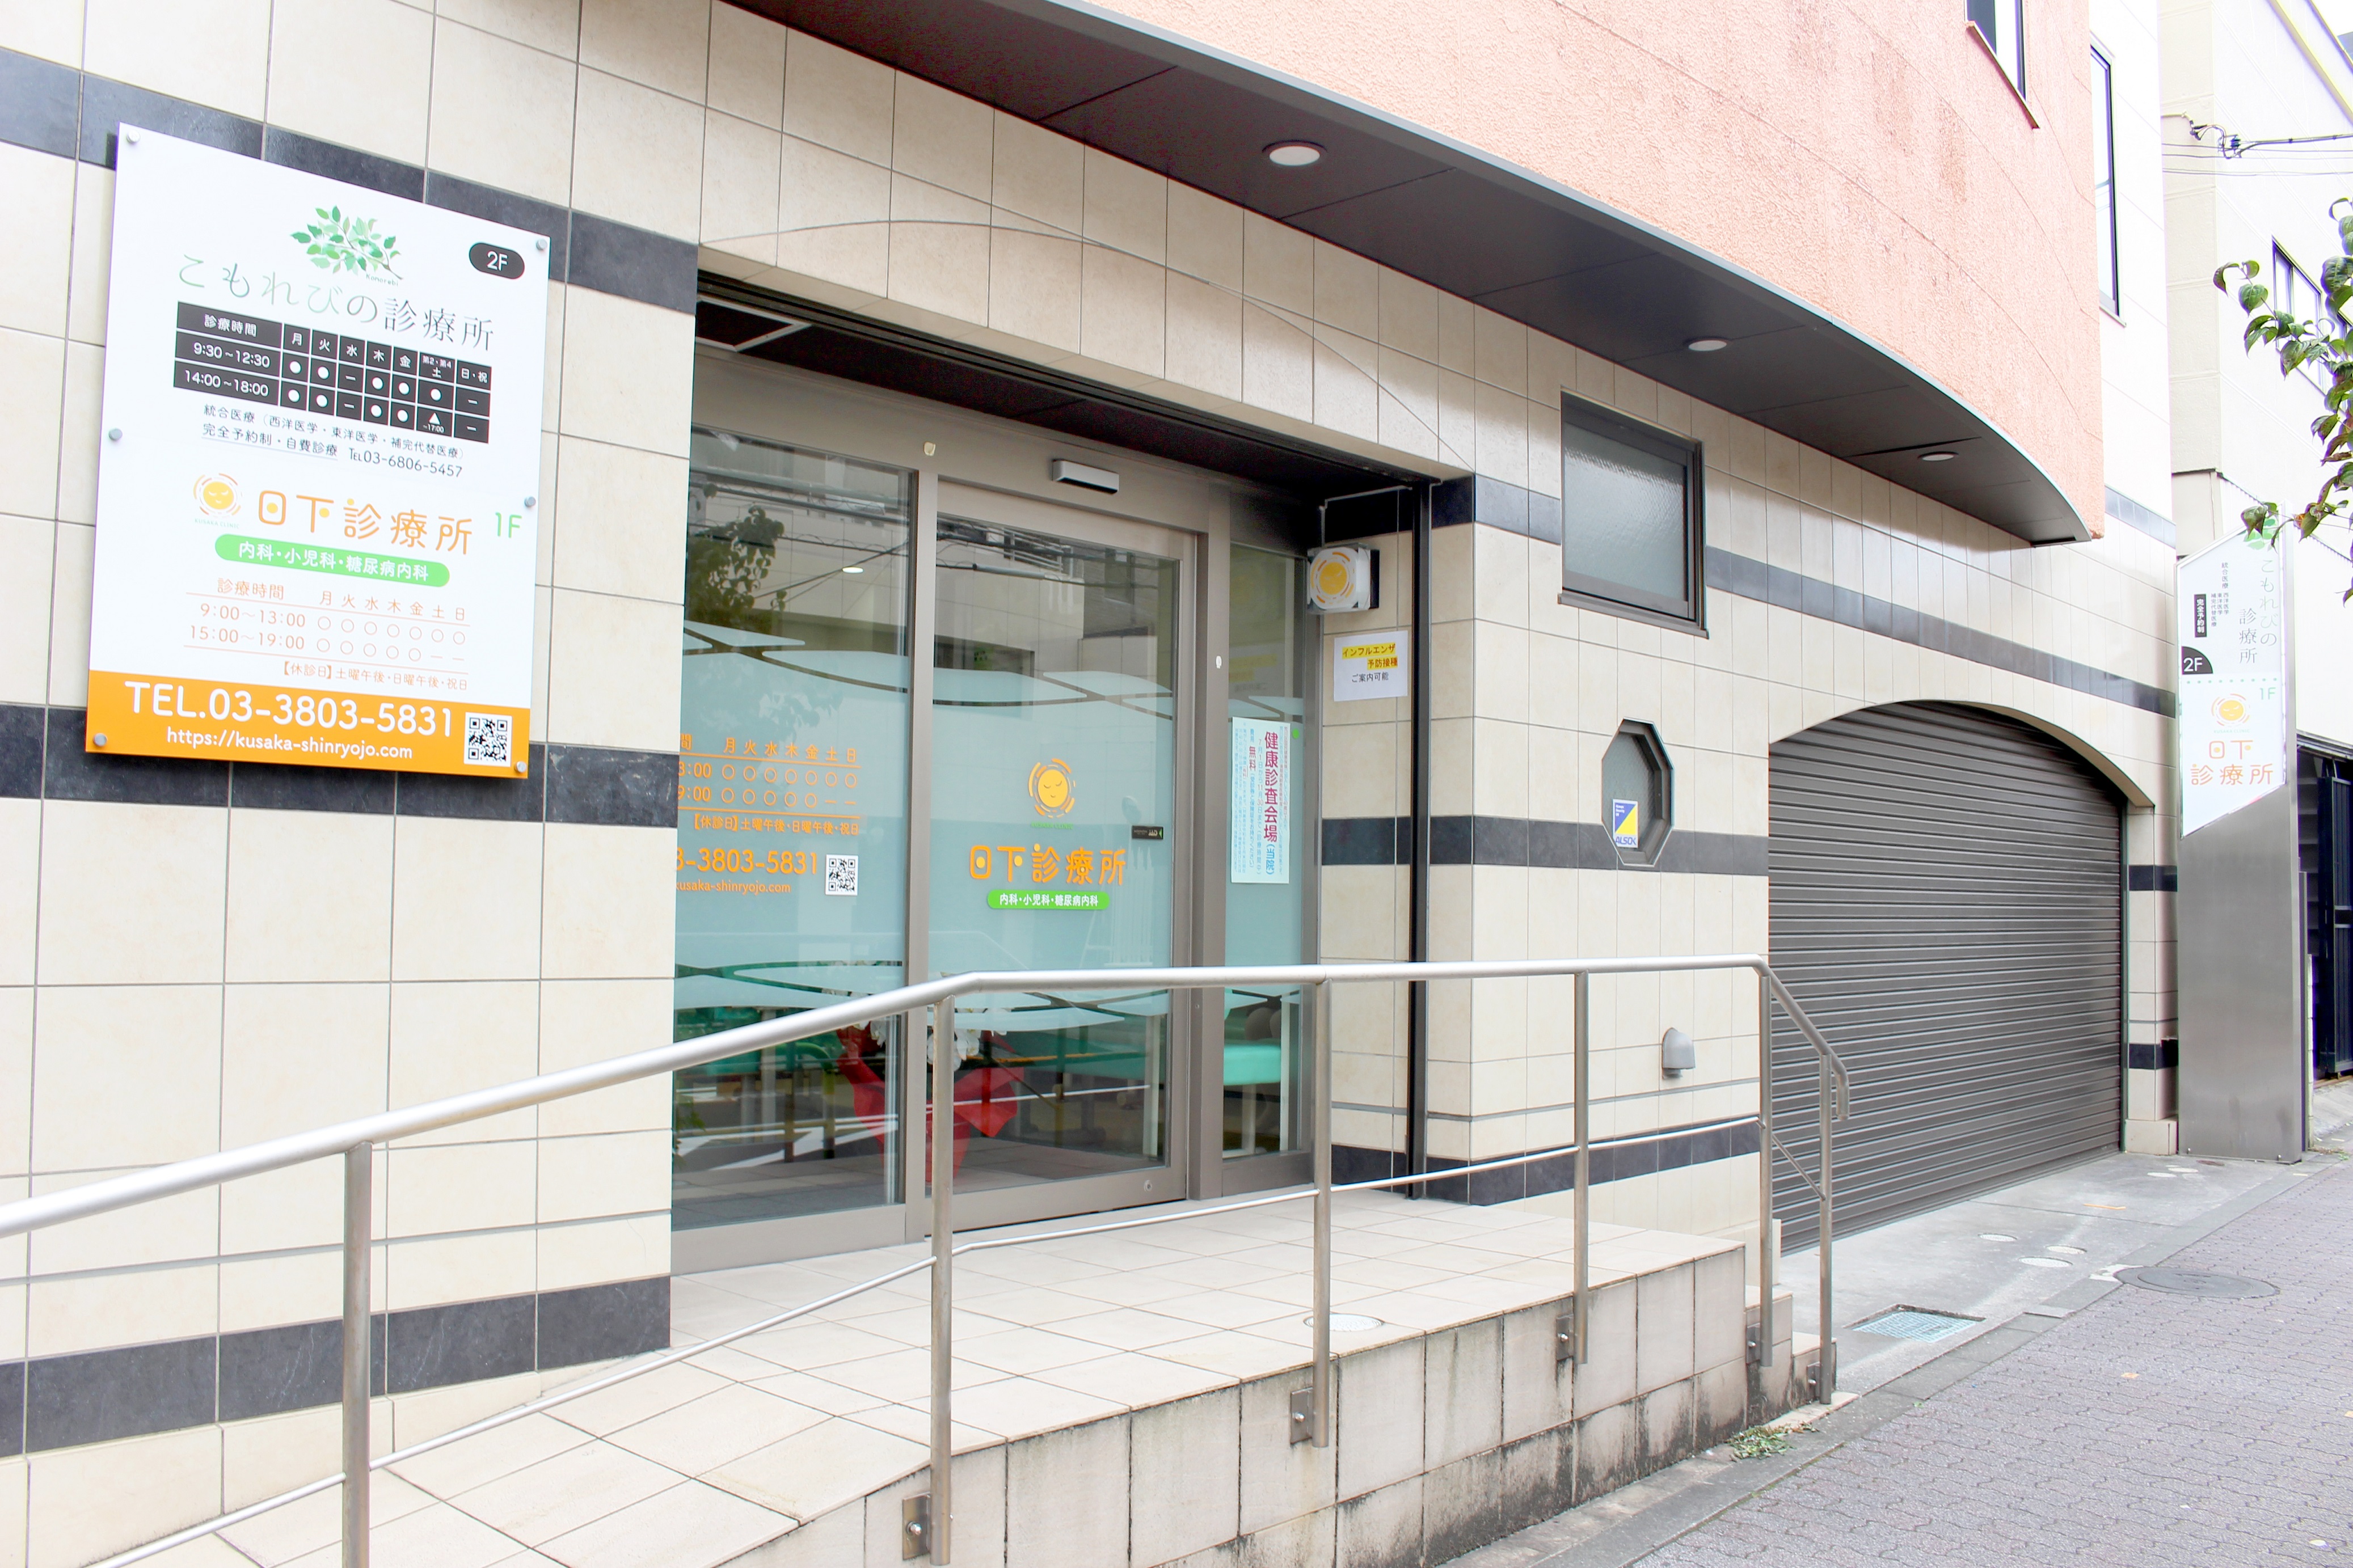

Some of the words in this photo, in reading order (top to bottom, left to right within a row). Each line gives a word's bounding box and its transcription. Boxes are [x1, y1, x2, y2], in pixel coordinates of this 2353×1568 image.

[487, 251, 508, 271] 2F
[179, 254, 494, 351] こもれびの診療所
[204, 314, 257, 337] 診療時間
[292, 332, 303, 346] 月
[318, 339, 331, 353] 火
[346, 344, 358, 357] 水
[373, 349, 385, 362] 木
[399, 355, 412, 369] 金
[432, 367, 442, 379] 土
[195, 518, 218, 526] KUSAKA
[258, 489, 474, 556] 日下診療所
[494, 512, 524, 539] 1F
[238, 540, 429, 582] 内科・小児科・糖尿病内科
[217, 577, 284, 601] 診療時間
[319, 590, 332, 606] 月
[341, 594, 356, 608] 火
[365, 596, 379, 611] 水
[387, 599, 402, 613] 木
[410, 601, 423, 616] 金
[432, 605, 445, 619] 土
[456, 607, 465, 621] 日
[2259, 559, 2279, 646] こもれびの
[2239, 608, 2258, 664] 診療所
[1343, 643, 1396, 657] インフルエンザ
[1367, 657, 1398, 669] 予防接種
[2183, 657, 2203, 672] 2F
[1351, 672, 1389, 683] ご案内可能
[2259, 687, 2276, 700] 1F
[124, 681, 452, 737] TEL.03-3803-5831
[167, 726, 414, 761] https://kusaka-shinryojo.com
[723, 737, 735, 754] 月
[743, 739, 757, 755] 火
[765, 741, 778, 756] 水
[785, 743, 799, 758] 木
[806, 744, 819, 760] 金
[825, 747, 838, 762] 土
[847, 749, 857, 763] 日
[2208, 739, 2253, 760] 日下
[2190, 763, 2274, 786] 診療所
[1616, 836, 1637, 846] ALSOK
[969, 843, 1127, 886] 日下診療所
[1000, 893, 1099, 907] 内科・小児科・糖尿病内科
